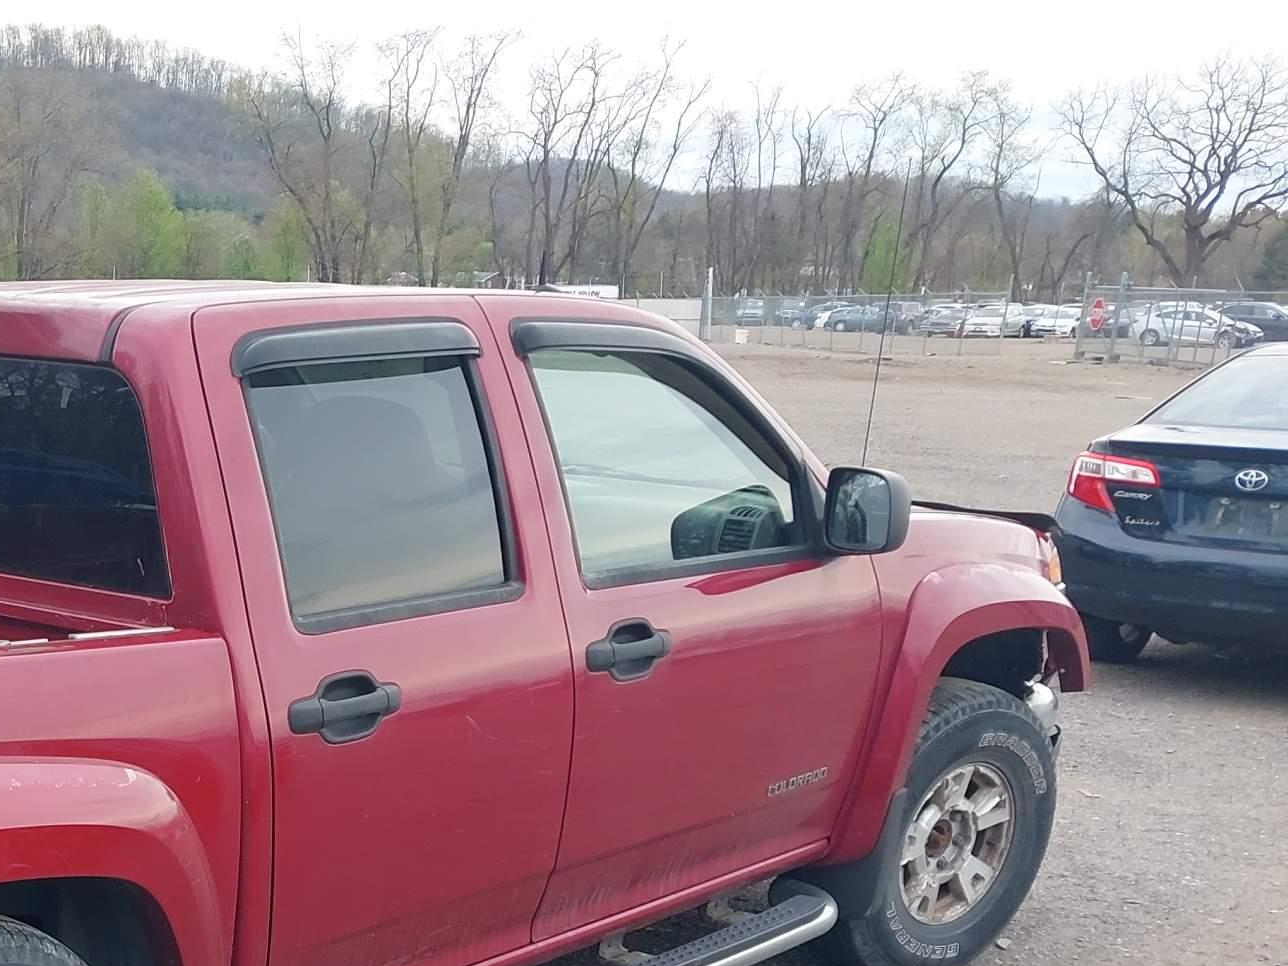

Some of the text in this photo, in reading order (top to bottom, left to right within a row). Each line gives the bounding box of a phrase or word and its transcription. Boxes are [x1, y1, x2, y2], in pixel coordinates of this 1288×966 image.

[767, 766, 828, 797] COLORADO
[978, 733, 1048, 795] GRABBER
[887, 901, 960, 959] GENERAL
